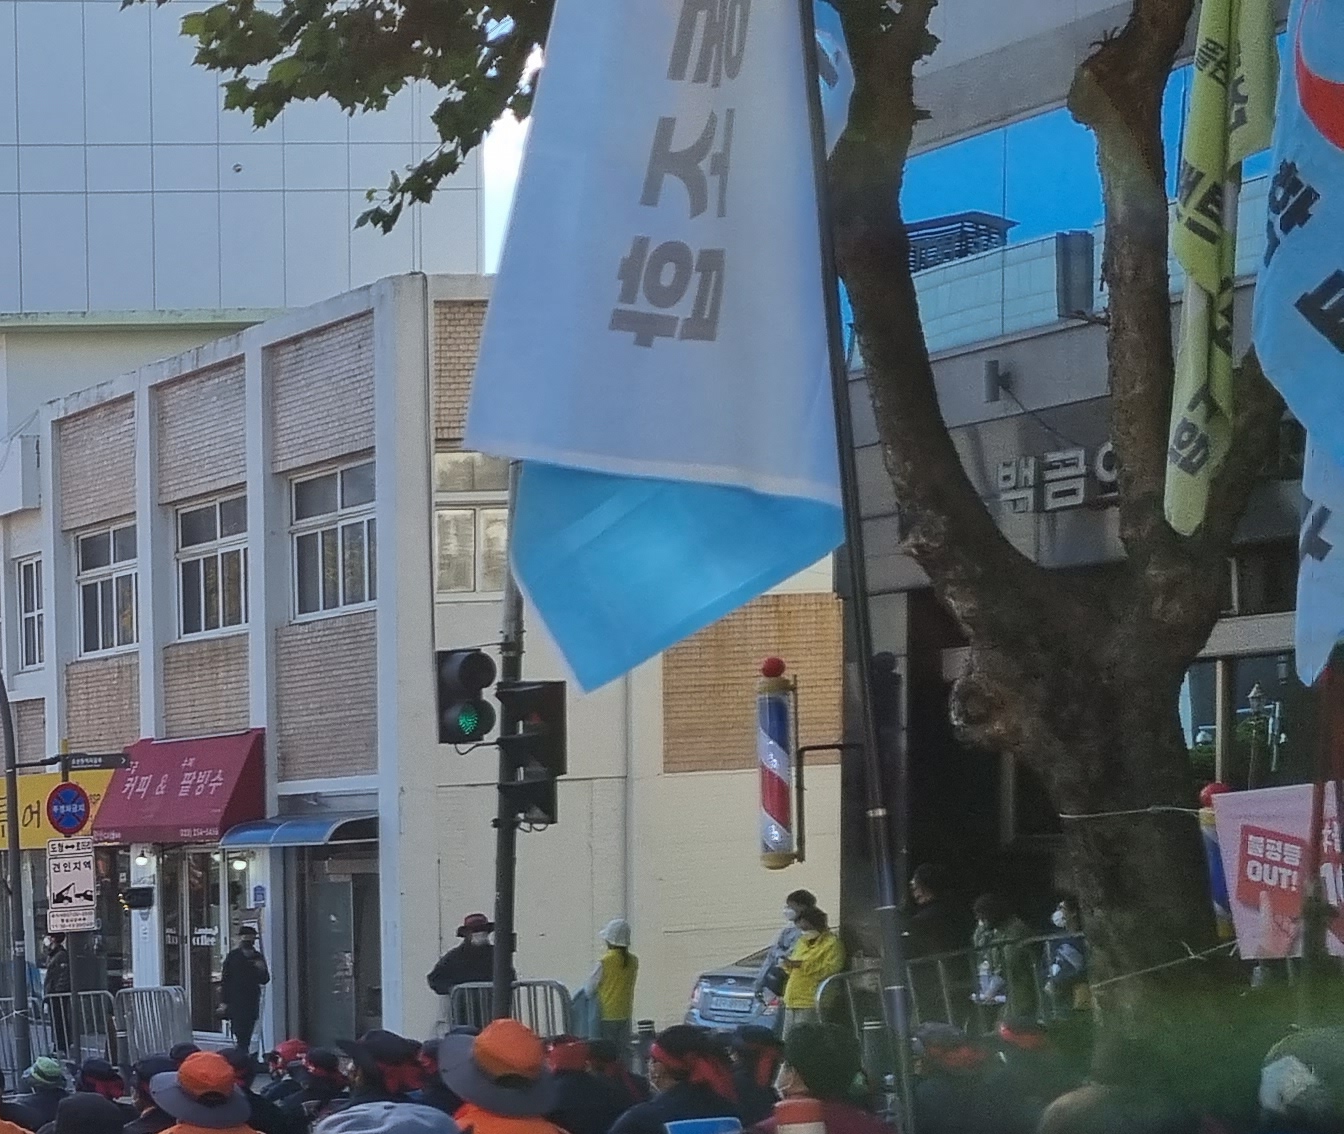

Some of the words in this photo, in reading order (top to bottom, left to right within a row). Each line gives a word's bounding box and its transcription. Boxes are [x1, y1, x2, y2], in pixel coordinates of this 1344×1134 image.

[121, 775, 152, 800] 커피
[178, 769, 224, 797] 팥빙수
[52, 803, 85, 814] 주정차금지
[1246, 834, 1303, 867] 불평등
[52, 860, 92, 873] 견인지역
[1246, 859, 1299, 892] OUT!
